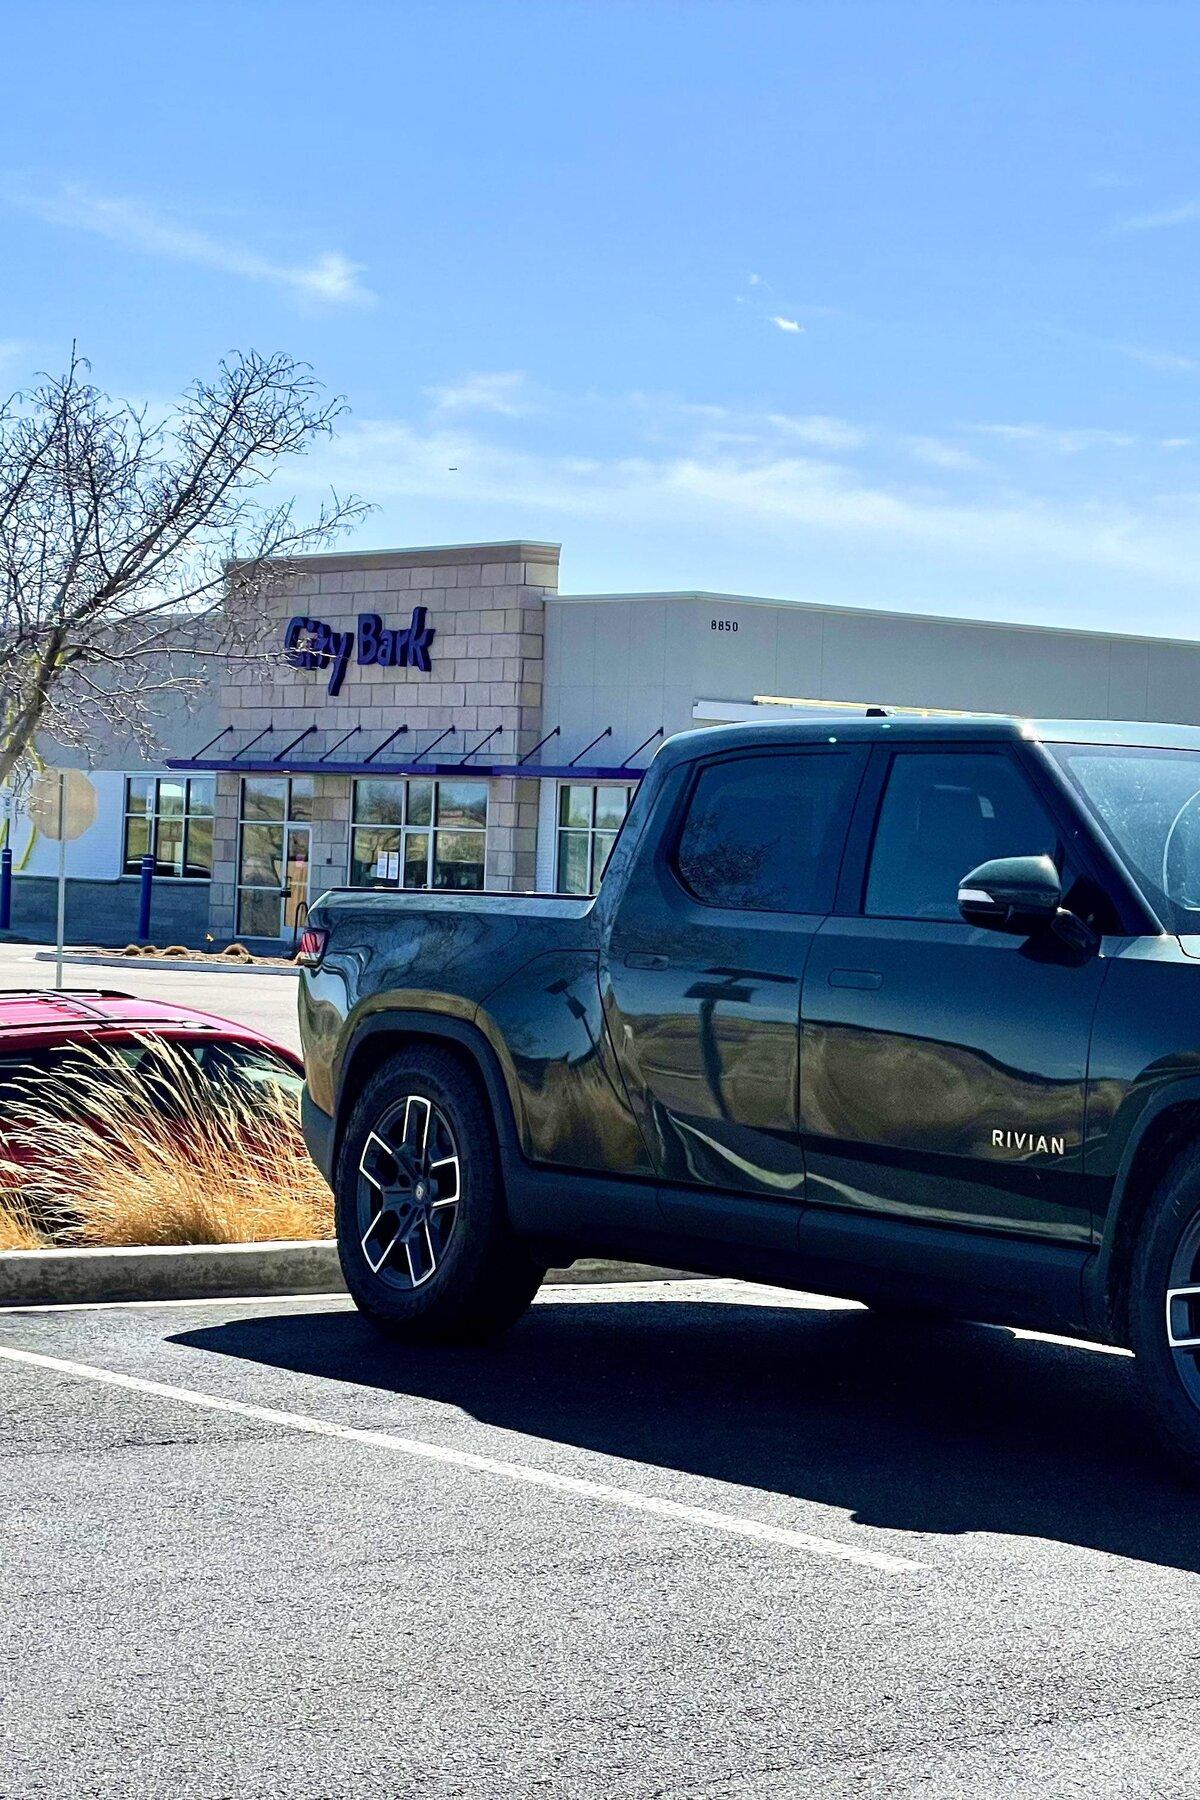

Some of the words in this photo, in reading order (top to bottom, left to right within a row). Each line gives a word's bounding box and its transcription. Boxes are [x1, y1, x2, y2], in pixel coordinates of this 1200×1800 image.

[711, 619, 738, 632] 8850
[285, 616, 354, 696] City
[357, 606, 436, 672] Bark
[992, 1129, 1065, 1155] RIVIAN
